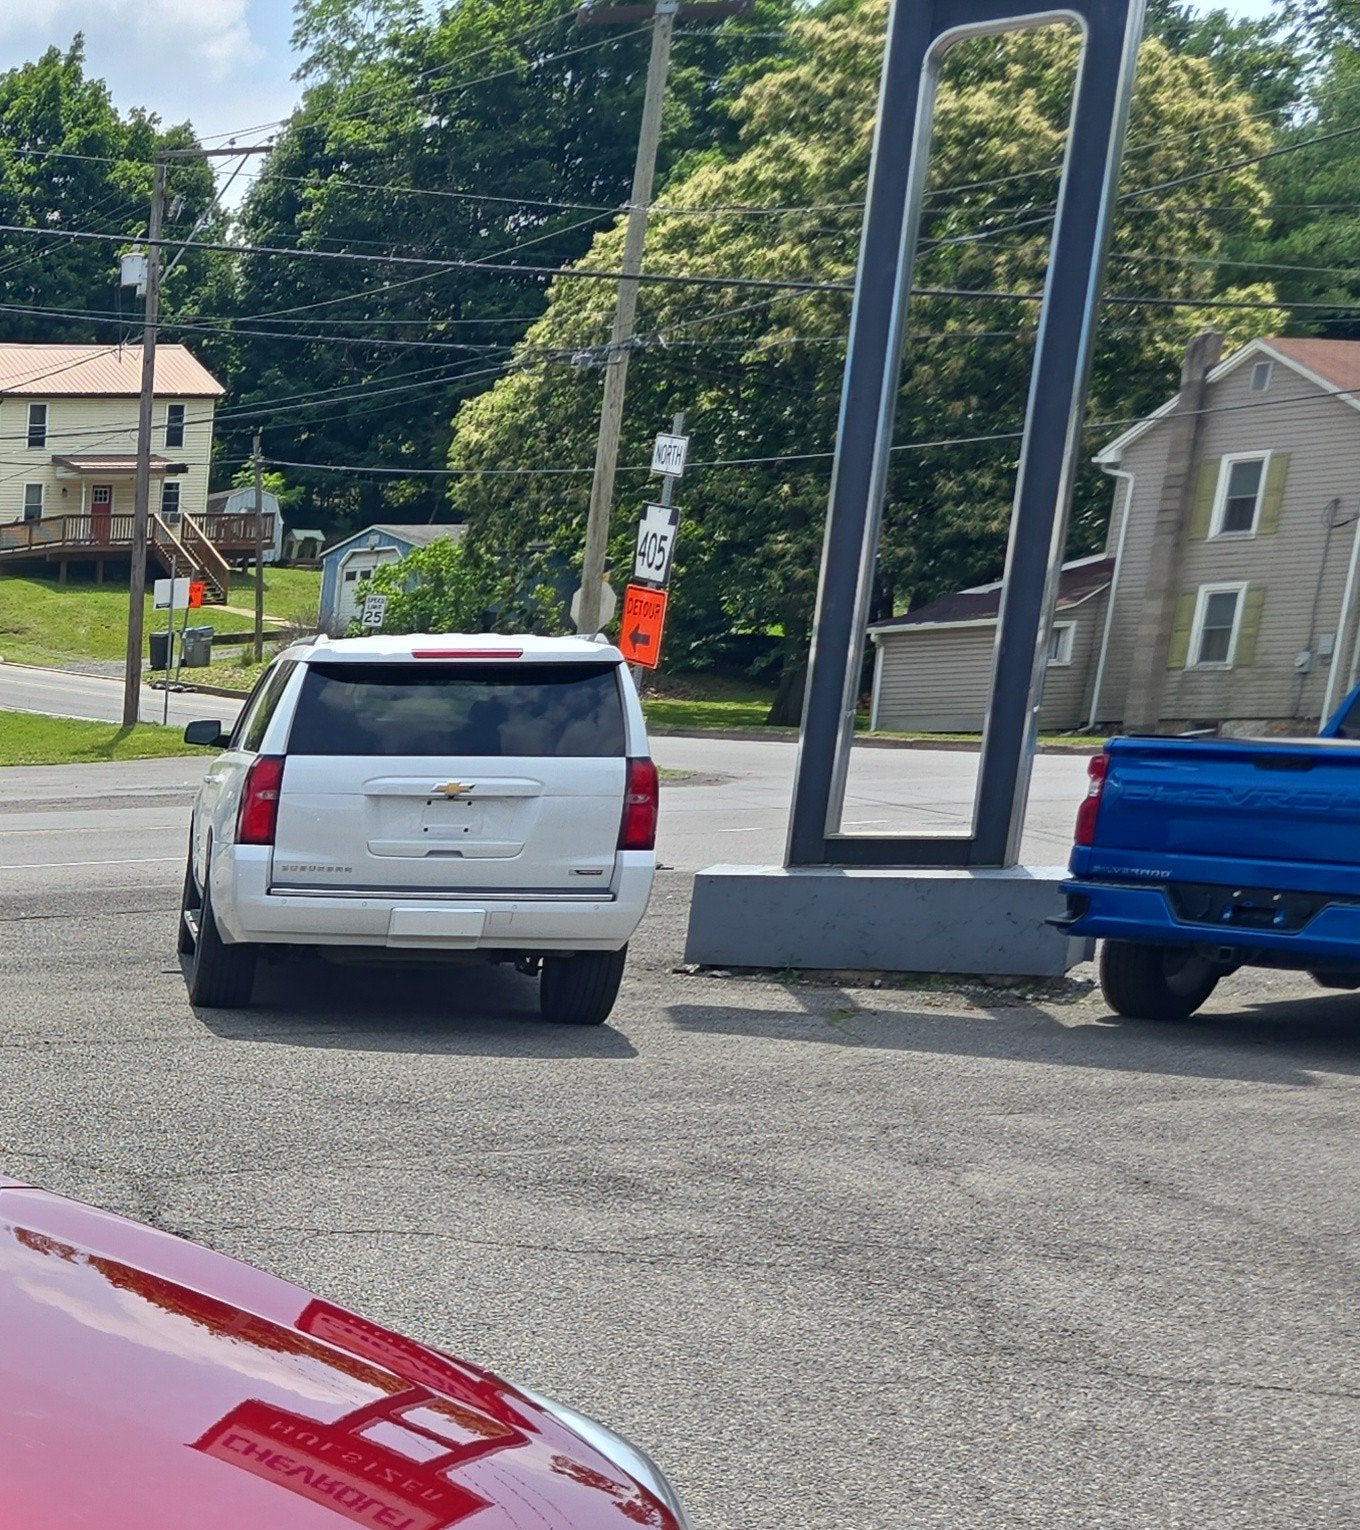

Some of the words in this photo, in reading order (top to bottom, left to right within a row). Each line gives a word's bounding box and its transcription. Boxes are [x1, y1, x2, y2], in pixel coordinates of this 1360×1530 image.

[655, 445, 682, 467] NORTH
[638, 530, 668, 577] 405
[364, 610, 382, 624] 25
[626, 596, 661, 621] DETOUR
[1093, 864, 1172, 878] SILVERADO
